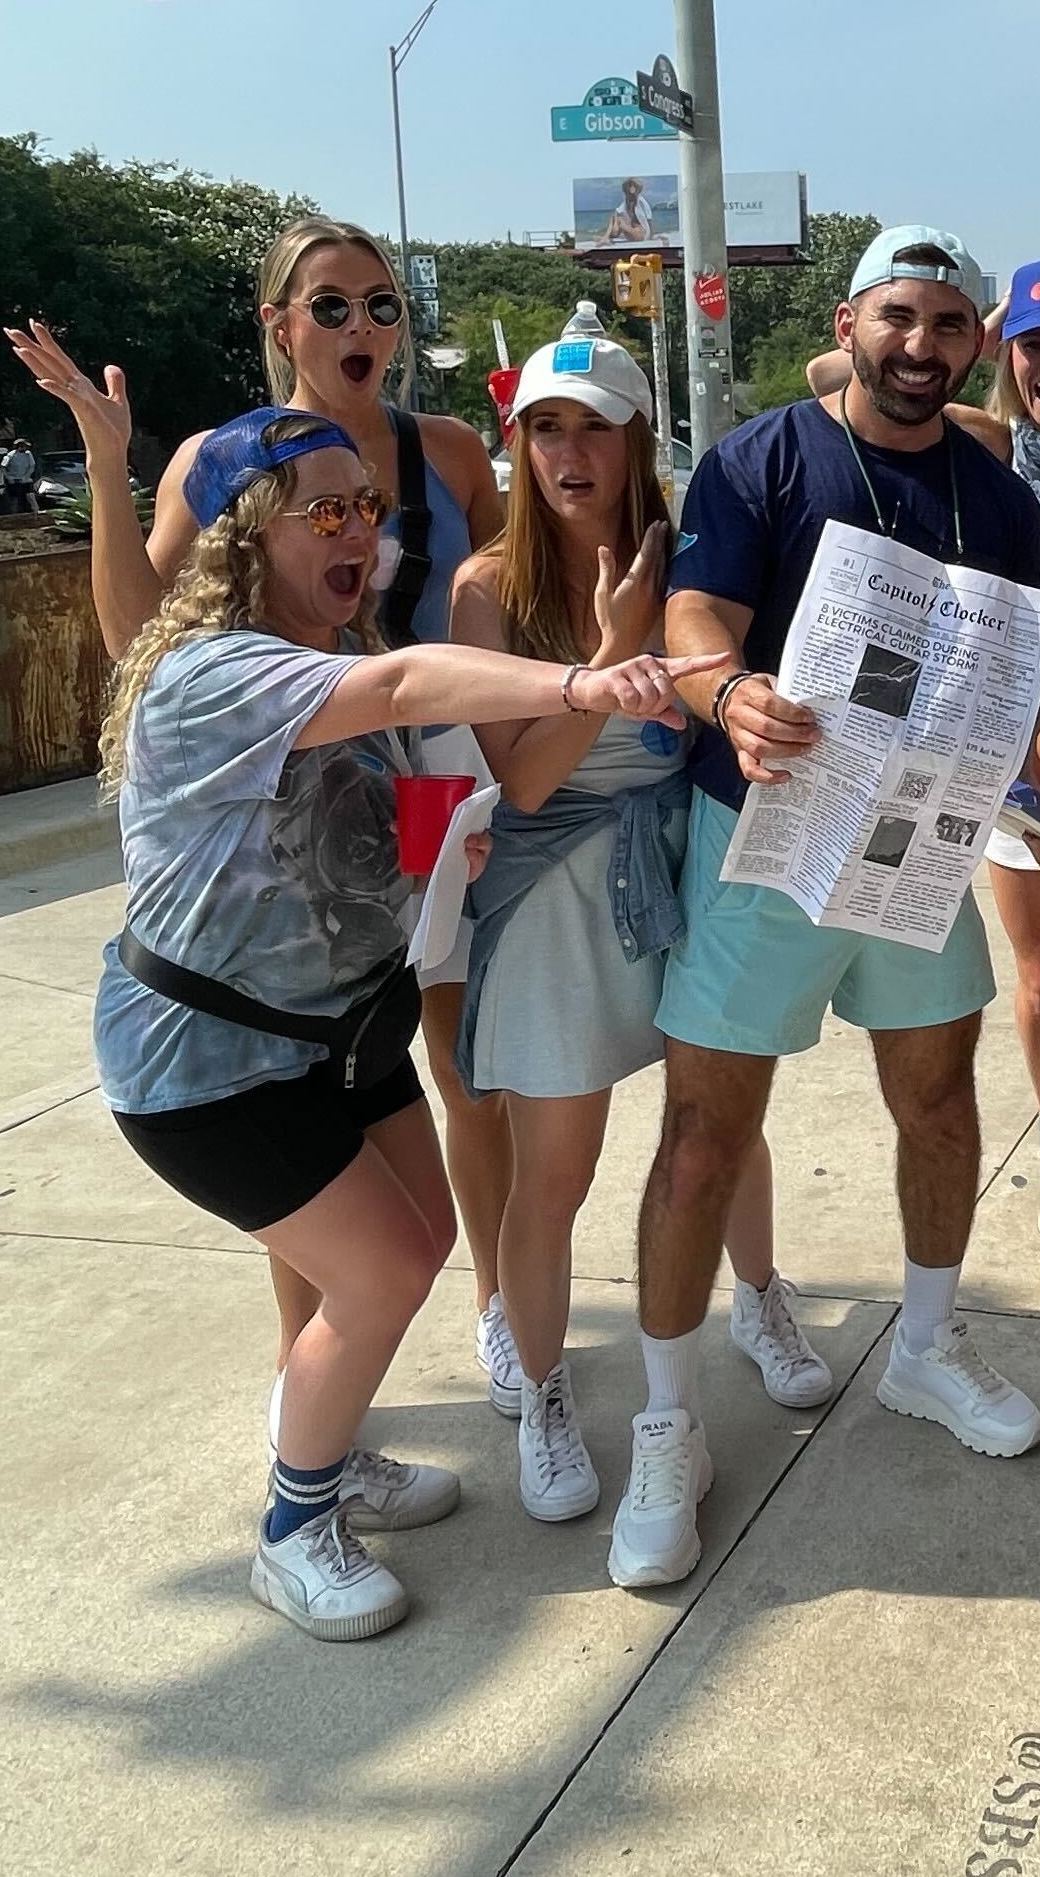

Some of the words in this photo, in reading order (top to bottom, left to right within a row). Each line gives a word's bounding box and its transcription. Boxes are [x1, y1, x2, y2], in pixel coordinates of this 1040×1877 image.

[648, 85, 685, 119] Congress
[559, 117, 568, 130] E
[584, 112, 645, 133] Gibson
[723, 200, 764, 210] ESTLAKE
[932, 576, 951, 591] The
[867, 573, 928, 609] Capitol
[940, 600, 1006, 632] Clocker
[817, 613, 888, 645] ELECTRICAL
[889, 638, 931, 661] GUITAR
[932, 652, 979, 672] STORM!
[821, 603, 830, 614] 8
[831, 605, 880, 630] VICTIMS
[881, 623, 931, 649] CLAIMED
[932, 641, 980, 662] DURING
[640, 1420, 674, 1432] PRADA
